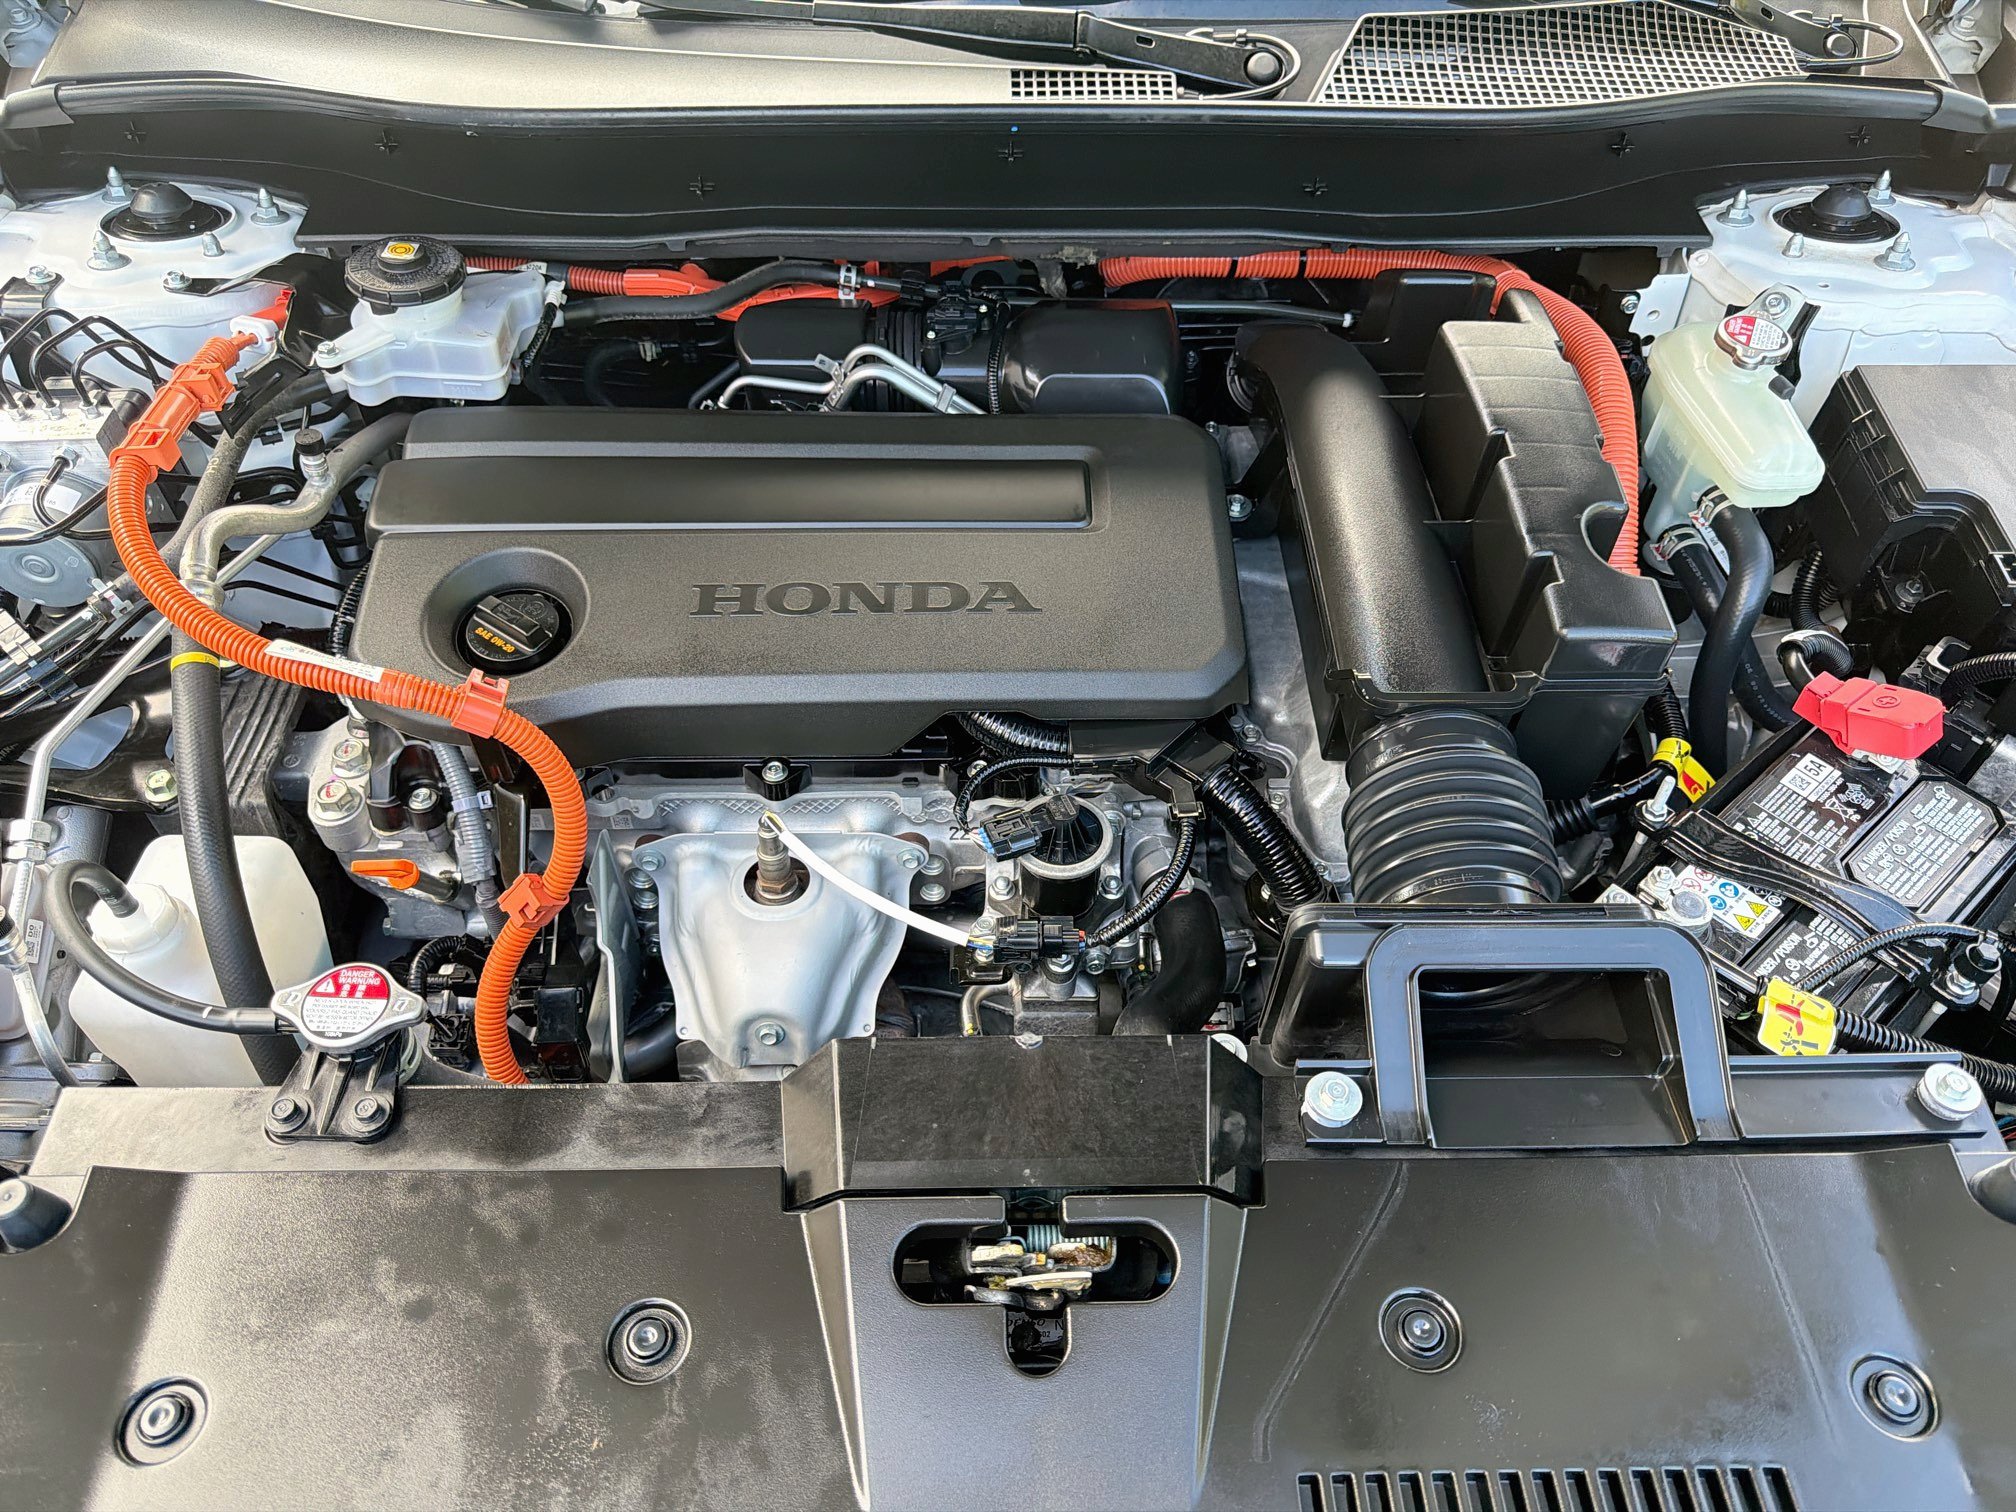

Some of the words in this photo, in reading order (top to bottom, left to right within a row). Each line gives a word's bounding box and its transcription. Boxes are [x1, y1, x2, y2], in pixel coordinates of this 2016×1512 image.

[689, 581, 1042, 617] HONDA
[474, 627, 493, 641] SAE
[490, 636, 515, 653] 0W-20
[1805, 759, 1827, 777] 5A
[1863, 819, 1910, 869] DANGER/POISON
[1754, 931, 1802, 979] ANGER/POISON
[338, 977, 381, 985] WARNUNG
